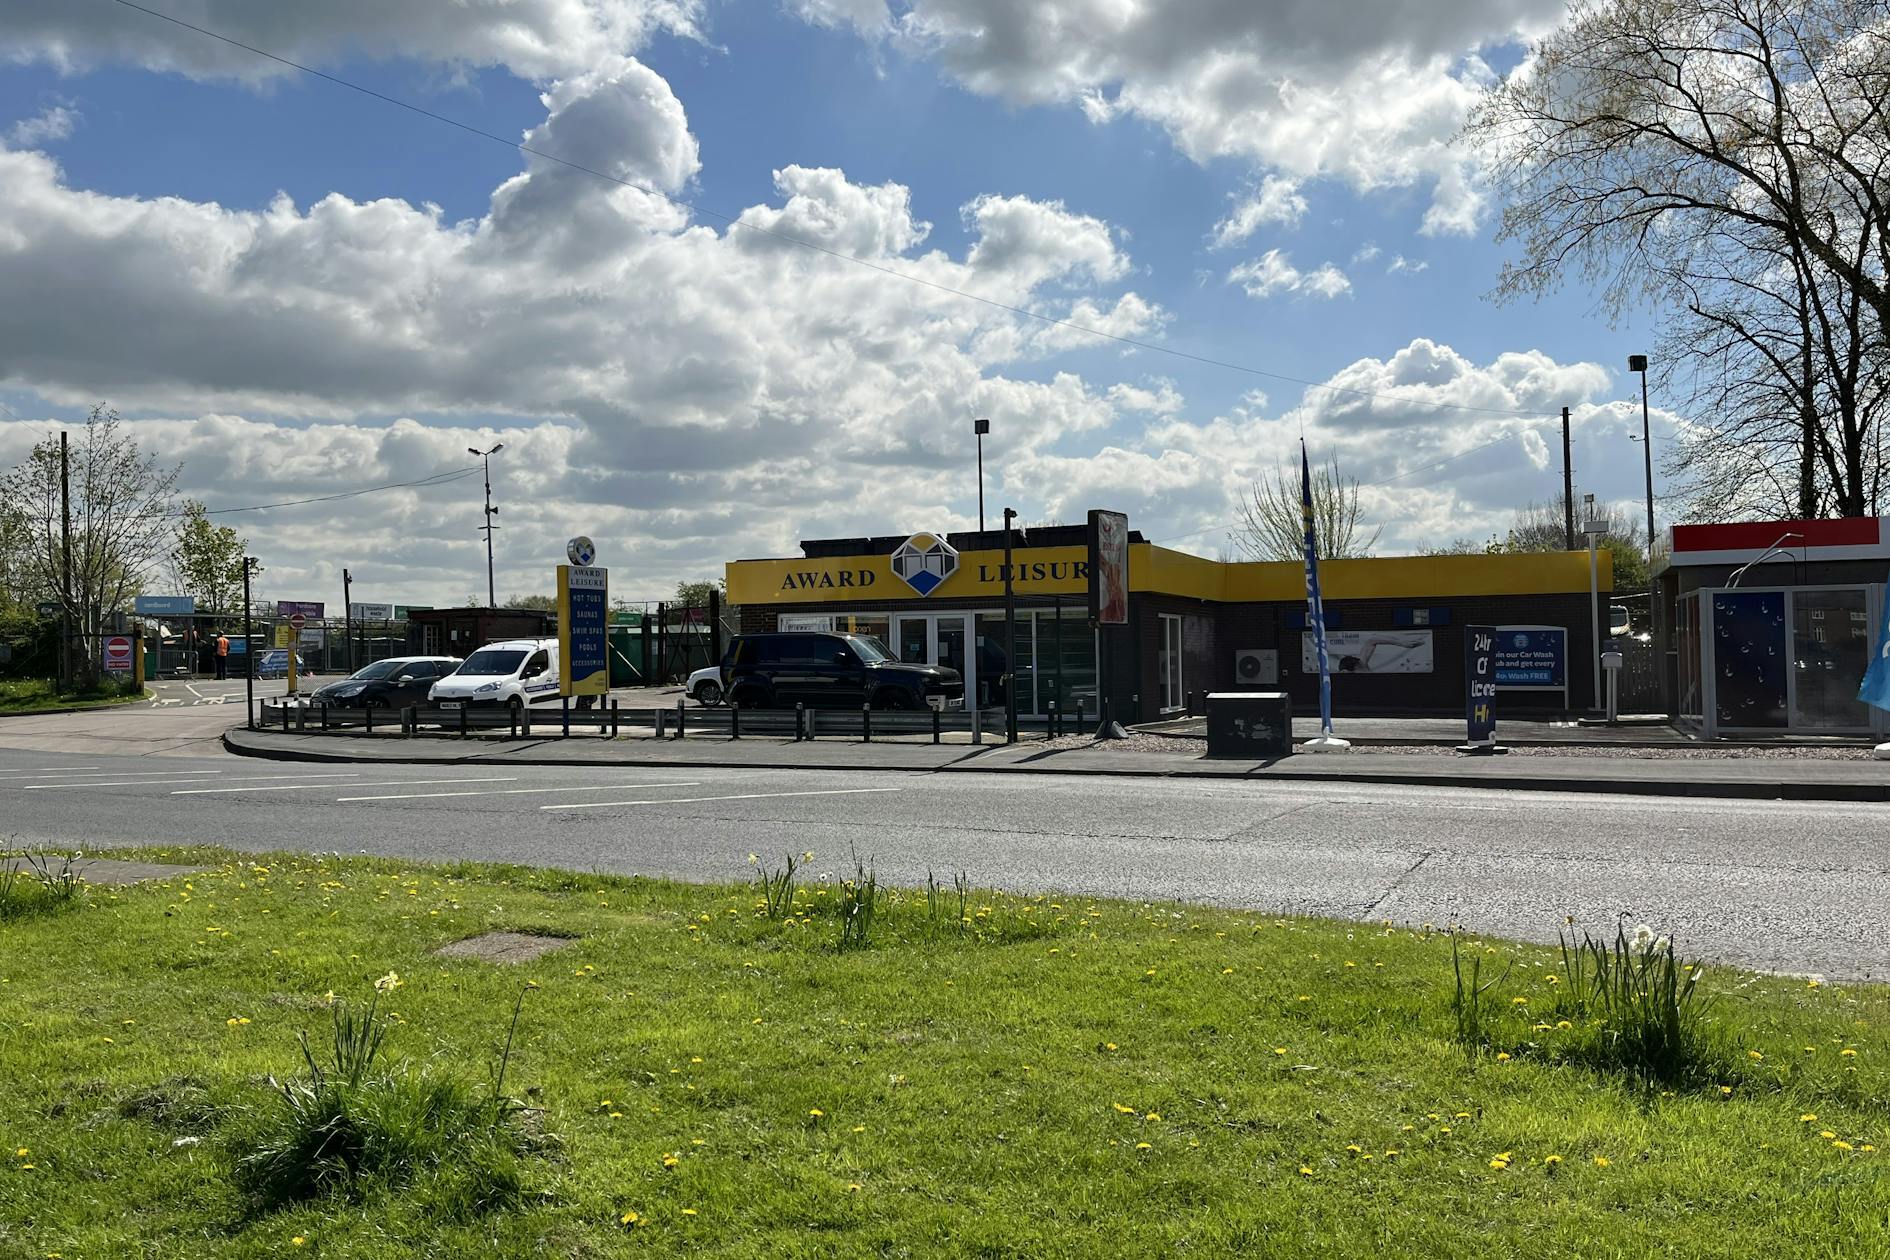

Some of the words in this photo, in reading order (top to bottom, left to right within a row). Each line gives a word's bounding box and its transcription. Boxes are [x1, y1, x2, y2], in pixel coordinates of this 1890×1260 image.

[575, 569, 600, 577] AWARD
[782, 570, 875, 590] AWARD
[978, 561, 1088, 582] LEISUR
[573, 594, 584, 602] HOT
[586, 595, 601, 603] TUBS
[572, 627, 588, 635] SWIM
[588, 627, 603, 635] SPAS
